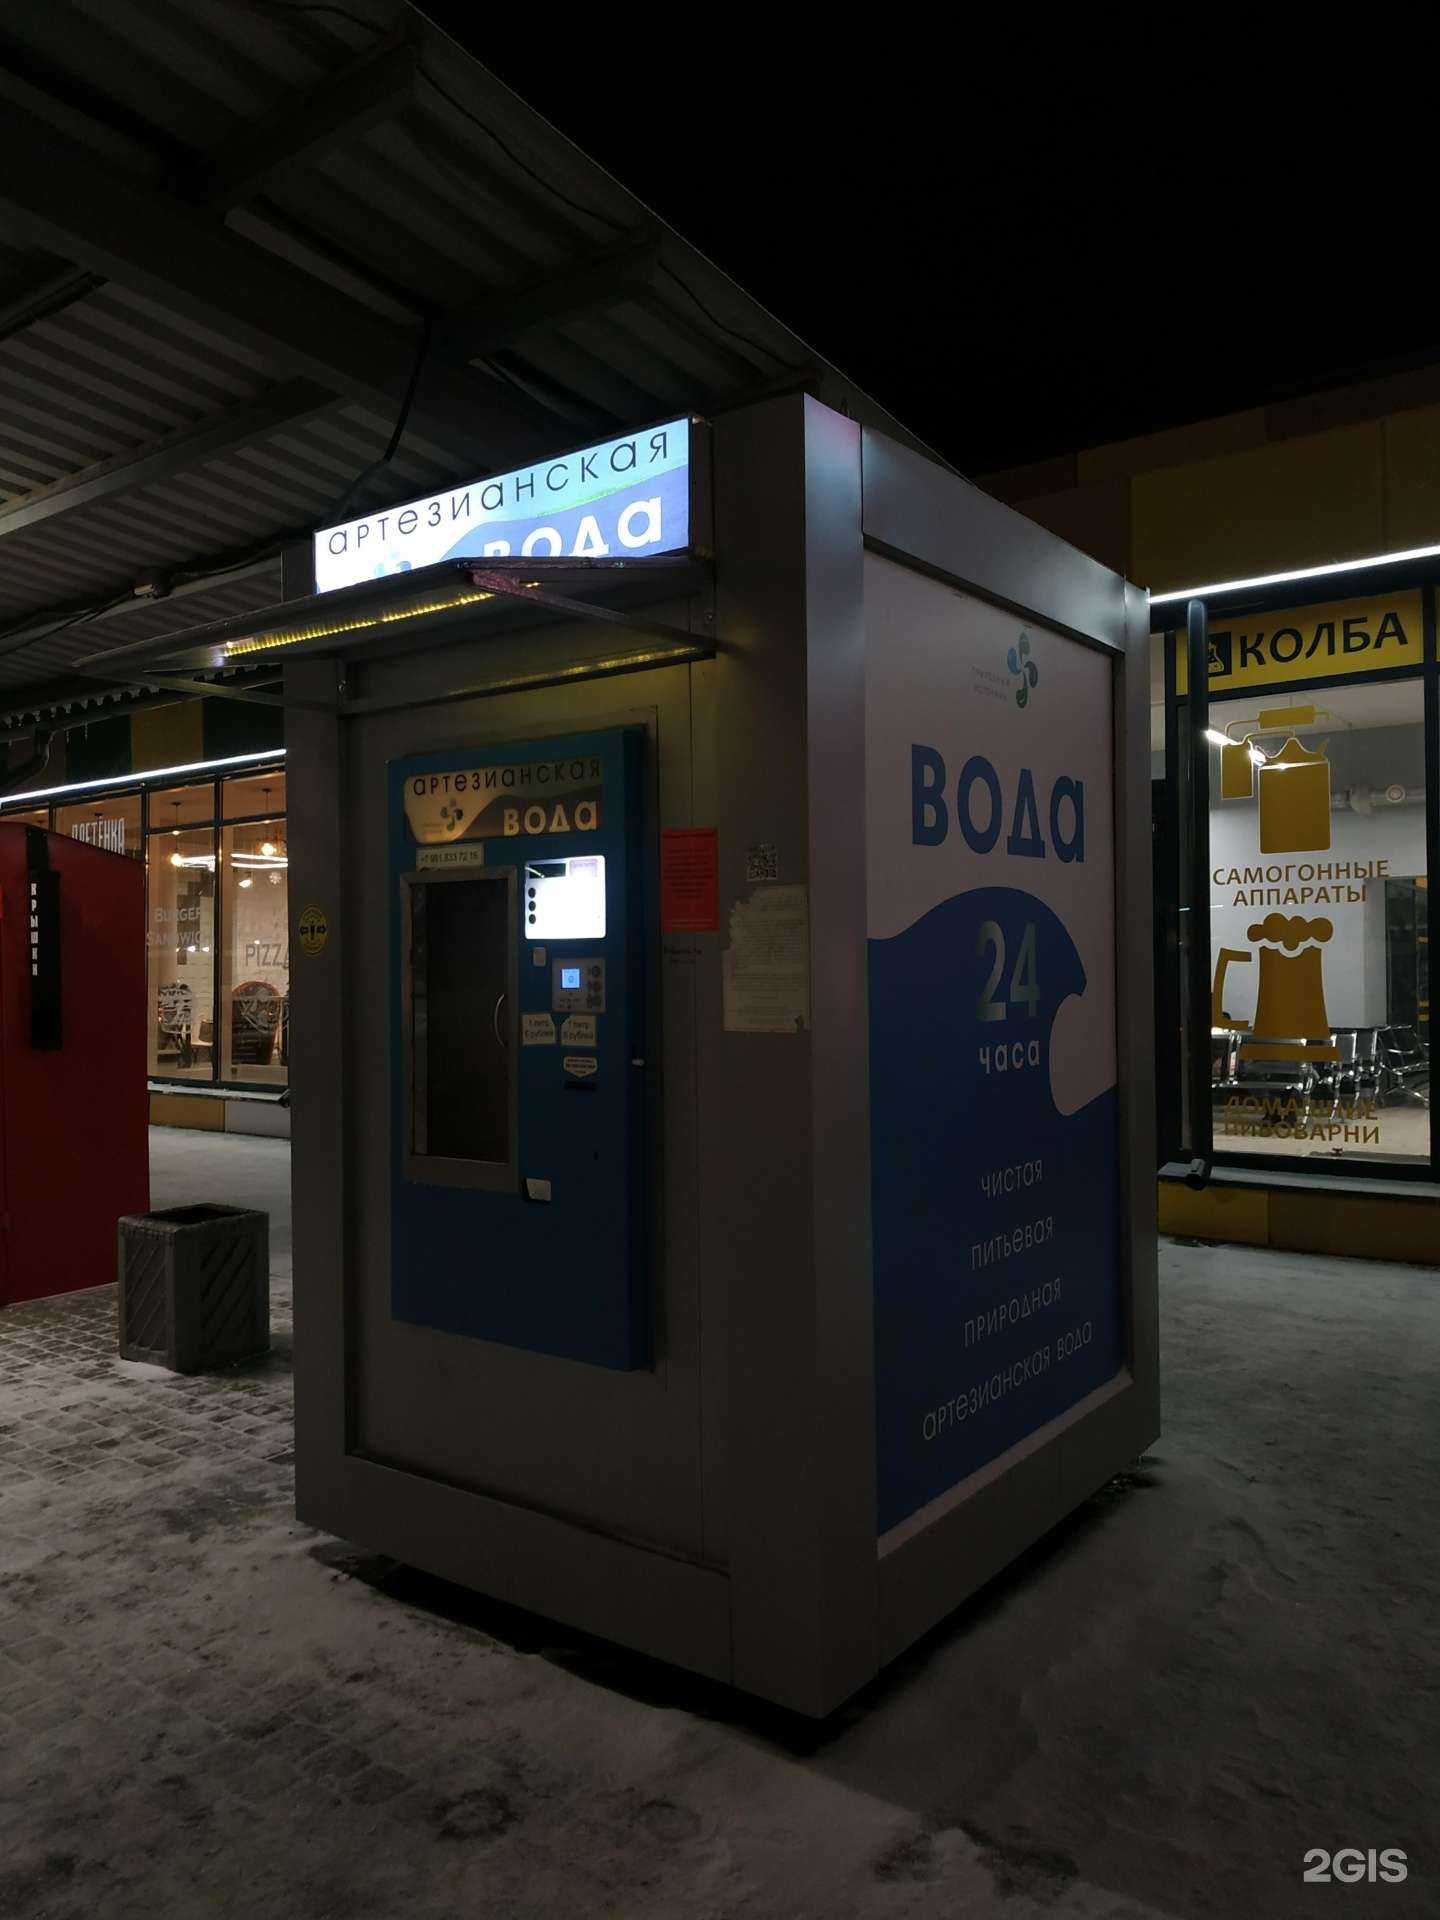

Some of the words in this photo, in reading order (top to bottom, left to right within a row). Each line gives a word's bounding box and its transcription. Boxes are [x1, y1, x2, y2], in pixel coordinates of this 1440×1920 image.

[328, 431, 669, 555] артезианская
[1239, 612, 1409, 668] КОЛБА
[413, 759, 600, 796] артезианская
[503, 800, 598, 837] вода
[911, 743, 1084, 863] вода
[1212, 859, 1391, 886] САМОГОННЫЕ
[1232, 884, 1367, 907] АППАРАТЫ
[975, 919, 1040, 1022] 24
[979, 1038, 1041, 1075] часа
[1224, 1121, 1379, 1144] ПИВОВАРНИ
[980, 1160, 1043, 1199] чистая
[970, 1216, 1054, 1270] питьевая
[963, 1278, 1062, 1349] природная
[922, 1345, 1051, 1441] артезианская
[1056, 1320, 1093, 1361] вода
